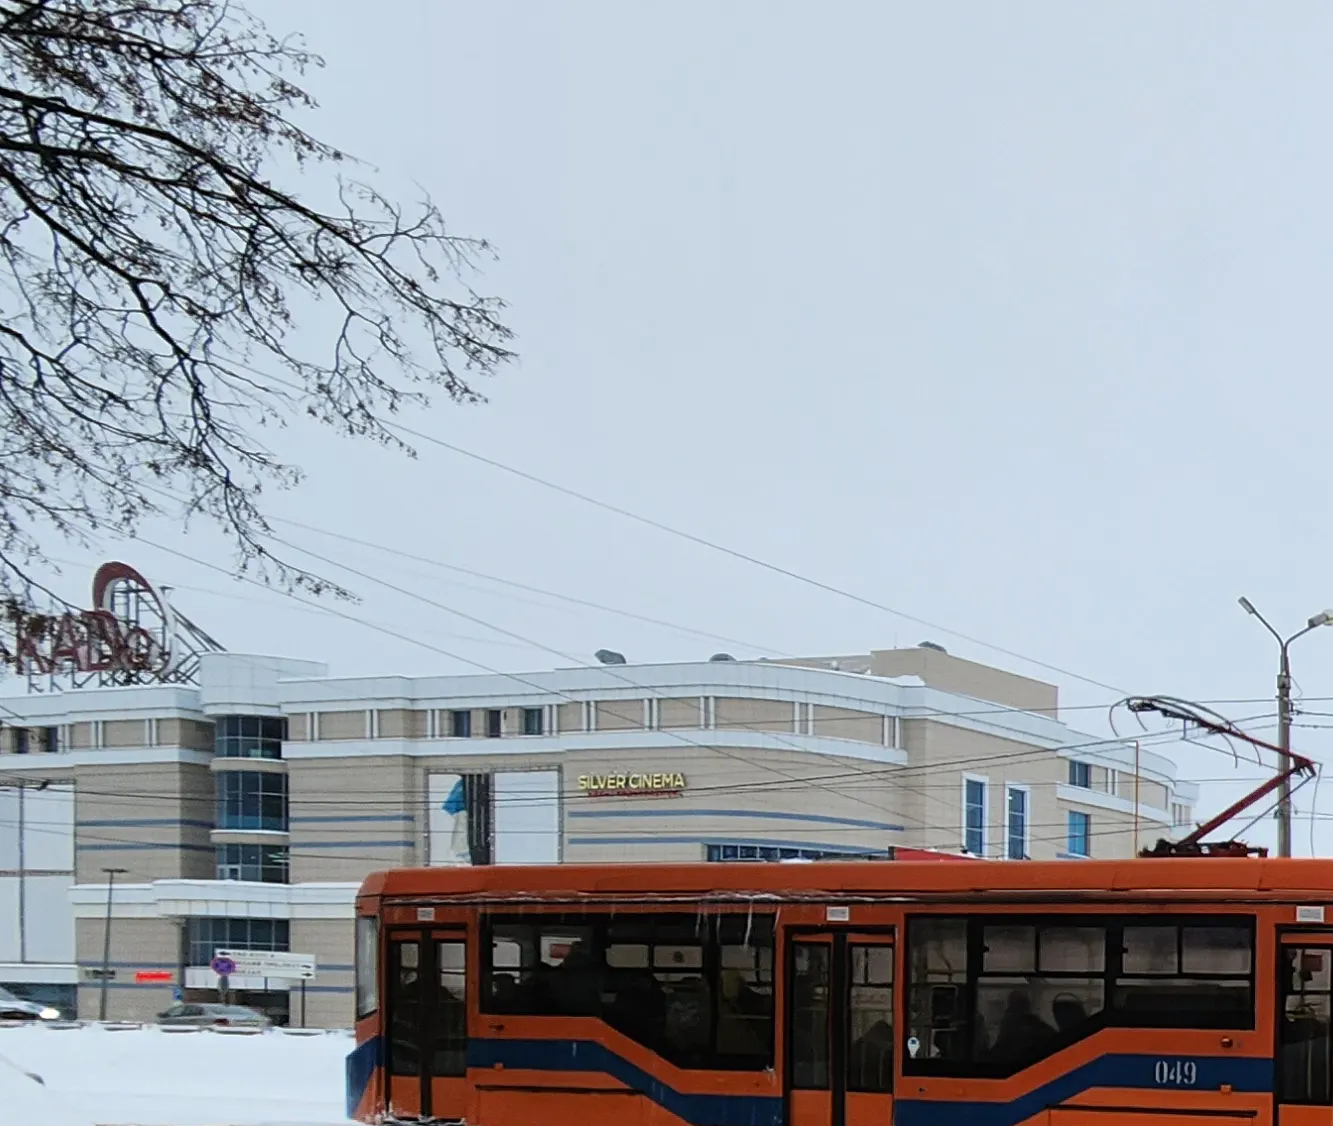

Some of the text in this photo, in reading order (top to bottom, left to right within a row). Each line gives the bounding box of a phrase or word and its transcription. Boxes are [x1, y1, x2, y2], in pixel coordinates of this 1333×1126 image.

[579, 773, 685, 789] SILVER CINEMA
[1155, 1061, 1196, 1085] 049
